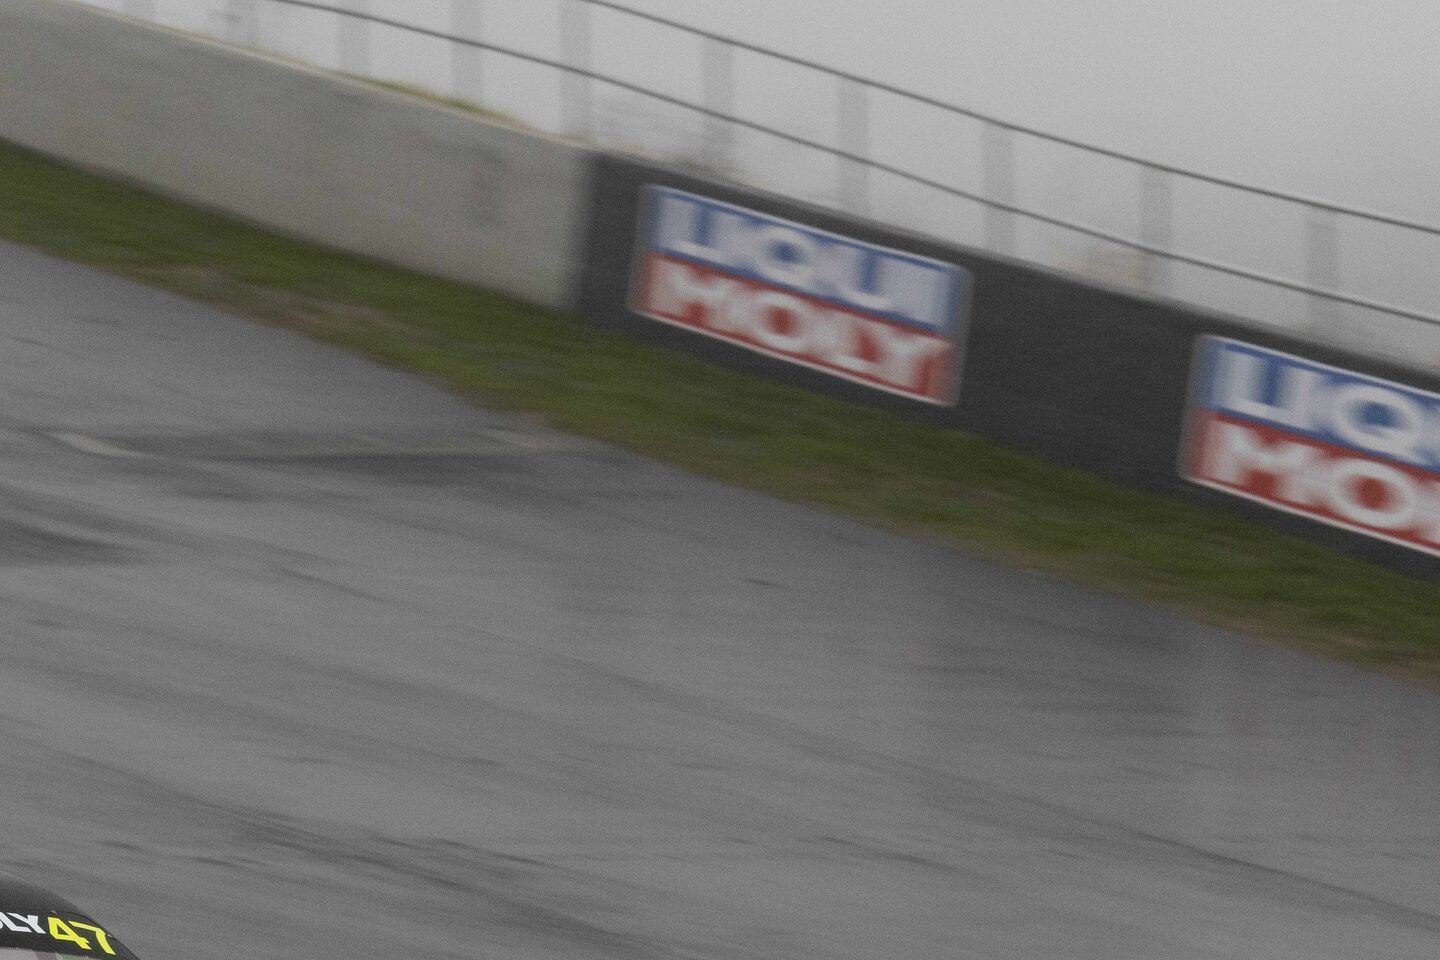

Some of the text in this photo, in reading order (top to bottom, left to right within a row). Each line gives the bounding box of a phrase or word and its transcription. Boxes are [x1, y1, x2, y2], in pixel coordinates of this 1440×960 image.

[652, 255, 956, 391] MOLY
[654, 197, 954, 331] LIQUI
[45, 916, 117, 955] 47
